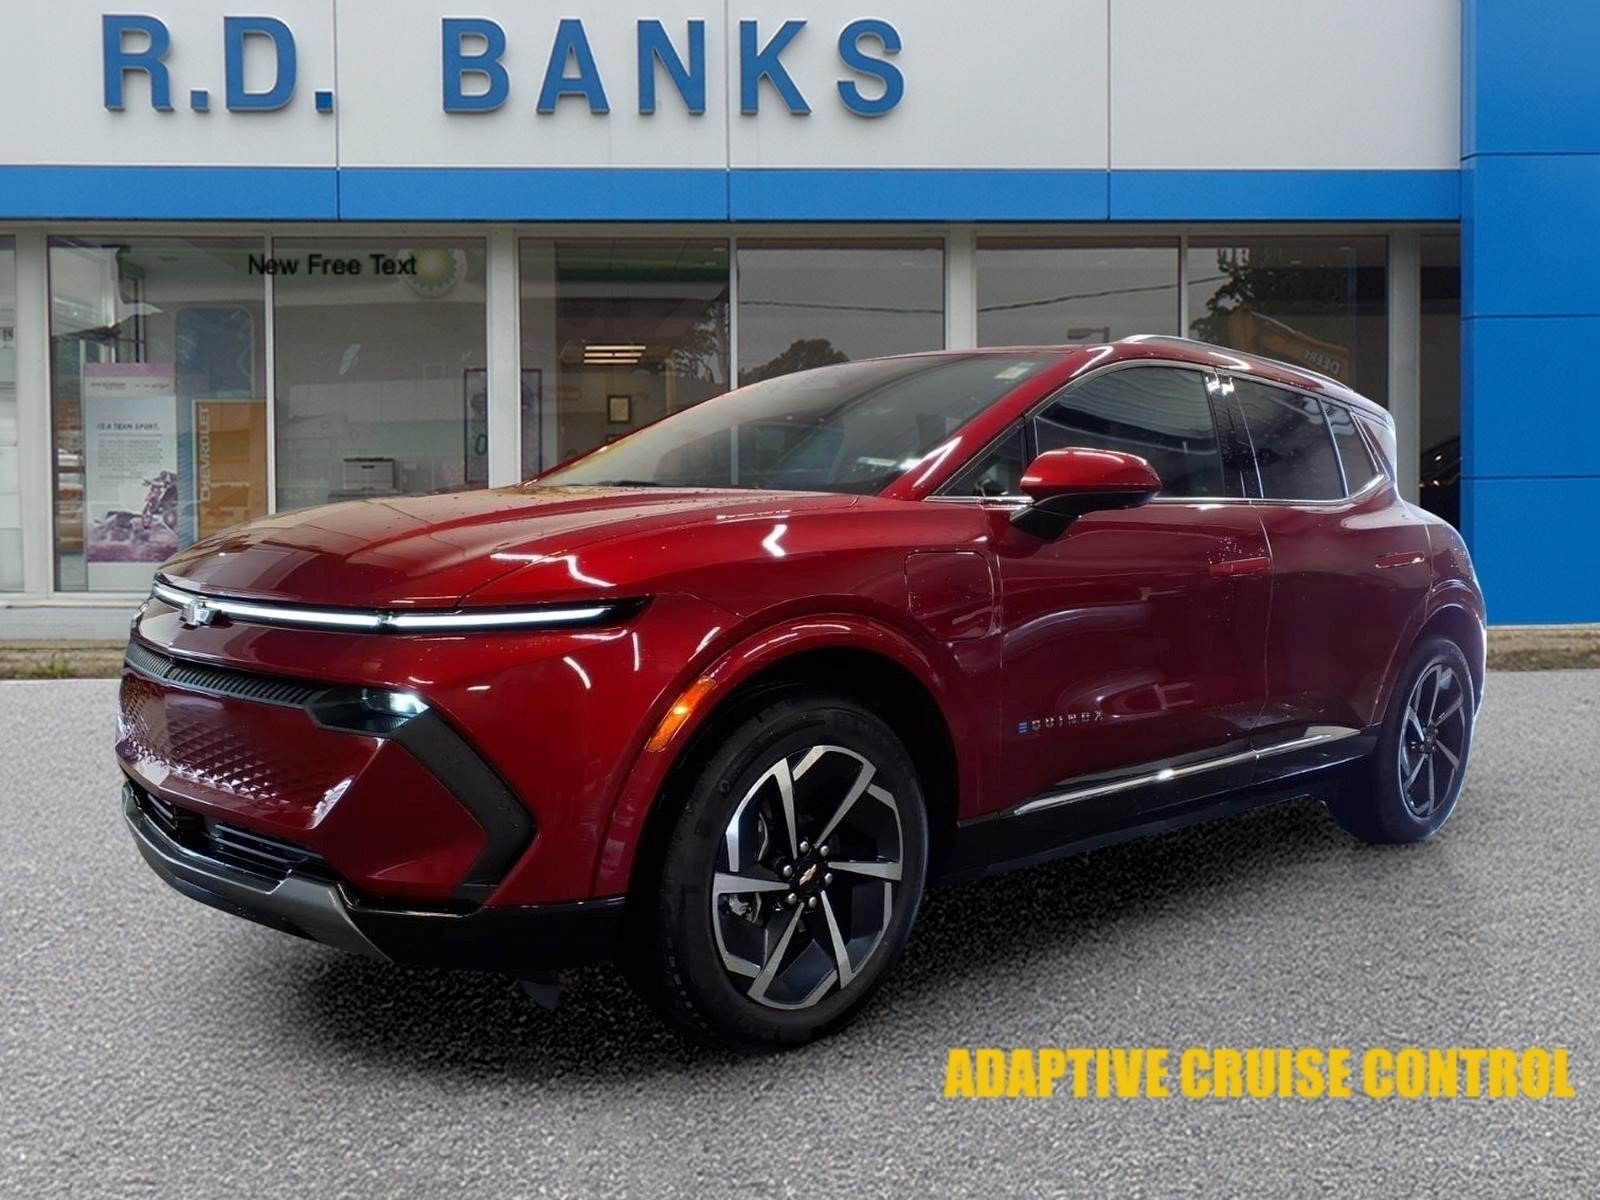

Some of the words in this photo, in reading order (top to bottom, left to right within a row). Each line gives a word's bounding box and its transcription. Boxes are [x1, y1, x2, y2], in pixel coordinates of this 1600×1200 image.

[103, 14, 334, 112] R.D.
[443, 18, 905, 116] BANKS
[199, 406, 211, 501] CHEVROLET
